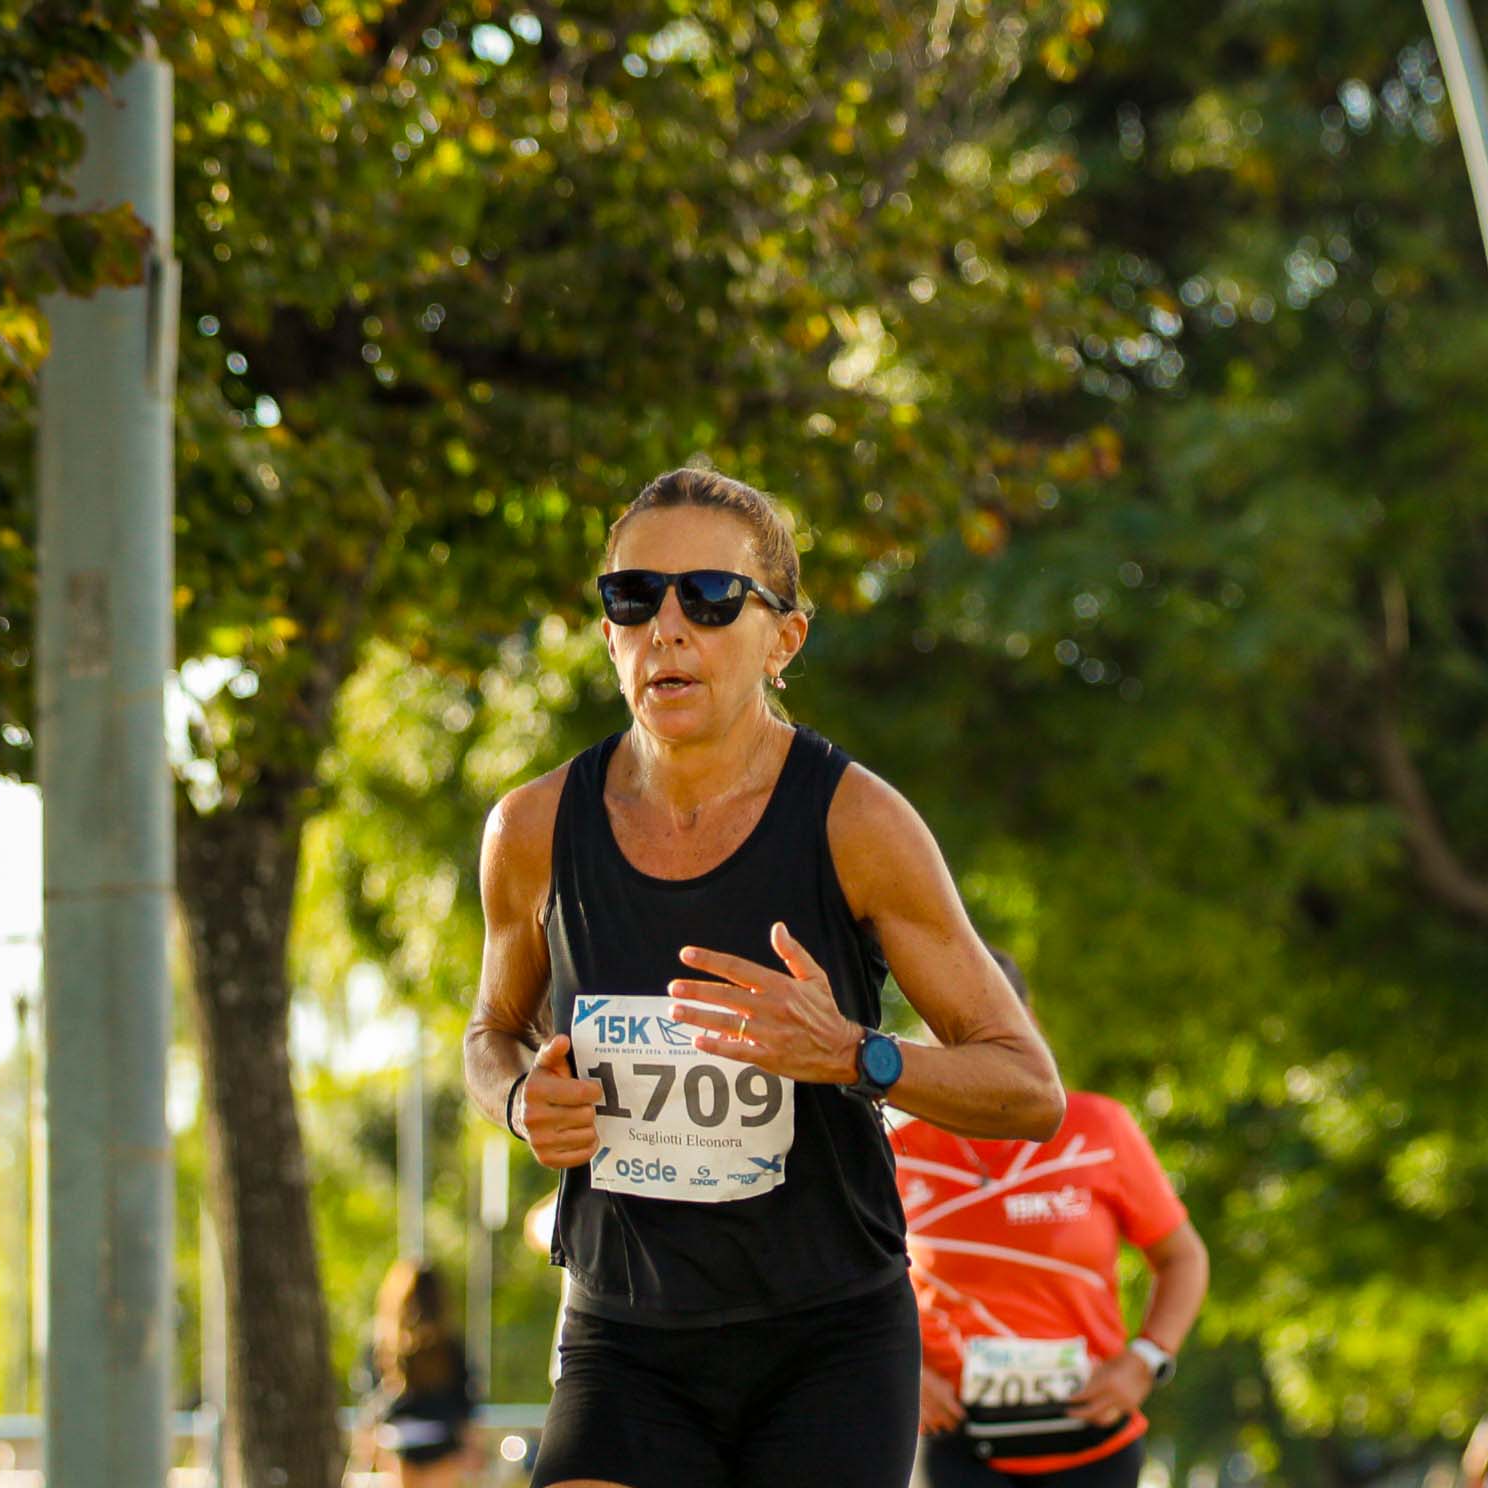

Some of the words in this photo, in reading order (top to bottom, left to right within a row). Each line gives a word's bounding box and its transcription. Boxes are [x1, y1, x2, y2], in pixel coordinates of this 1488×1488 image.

[594, 1016, 651, 1045] 15K
[587, 1062, 783, 1128] 1709
[628, 1128, 682, 1146] Scagliotti
[686, 1134, 742, 1148] Eleonora
[616, 1157, 677, 1183] osde
